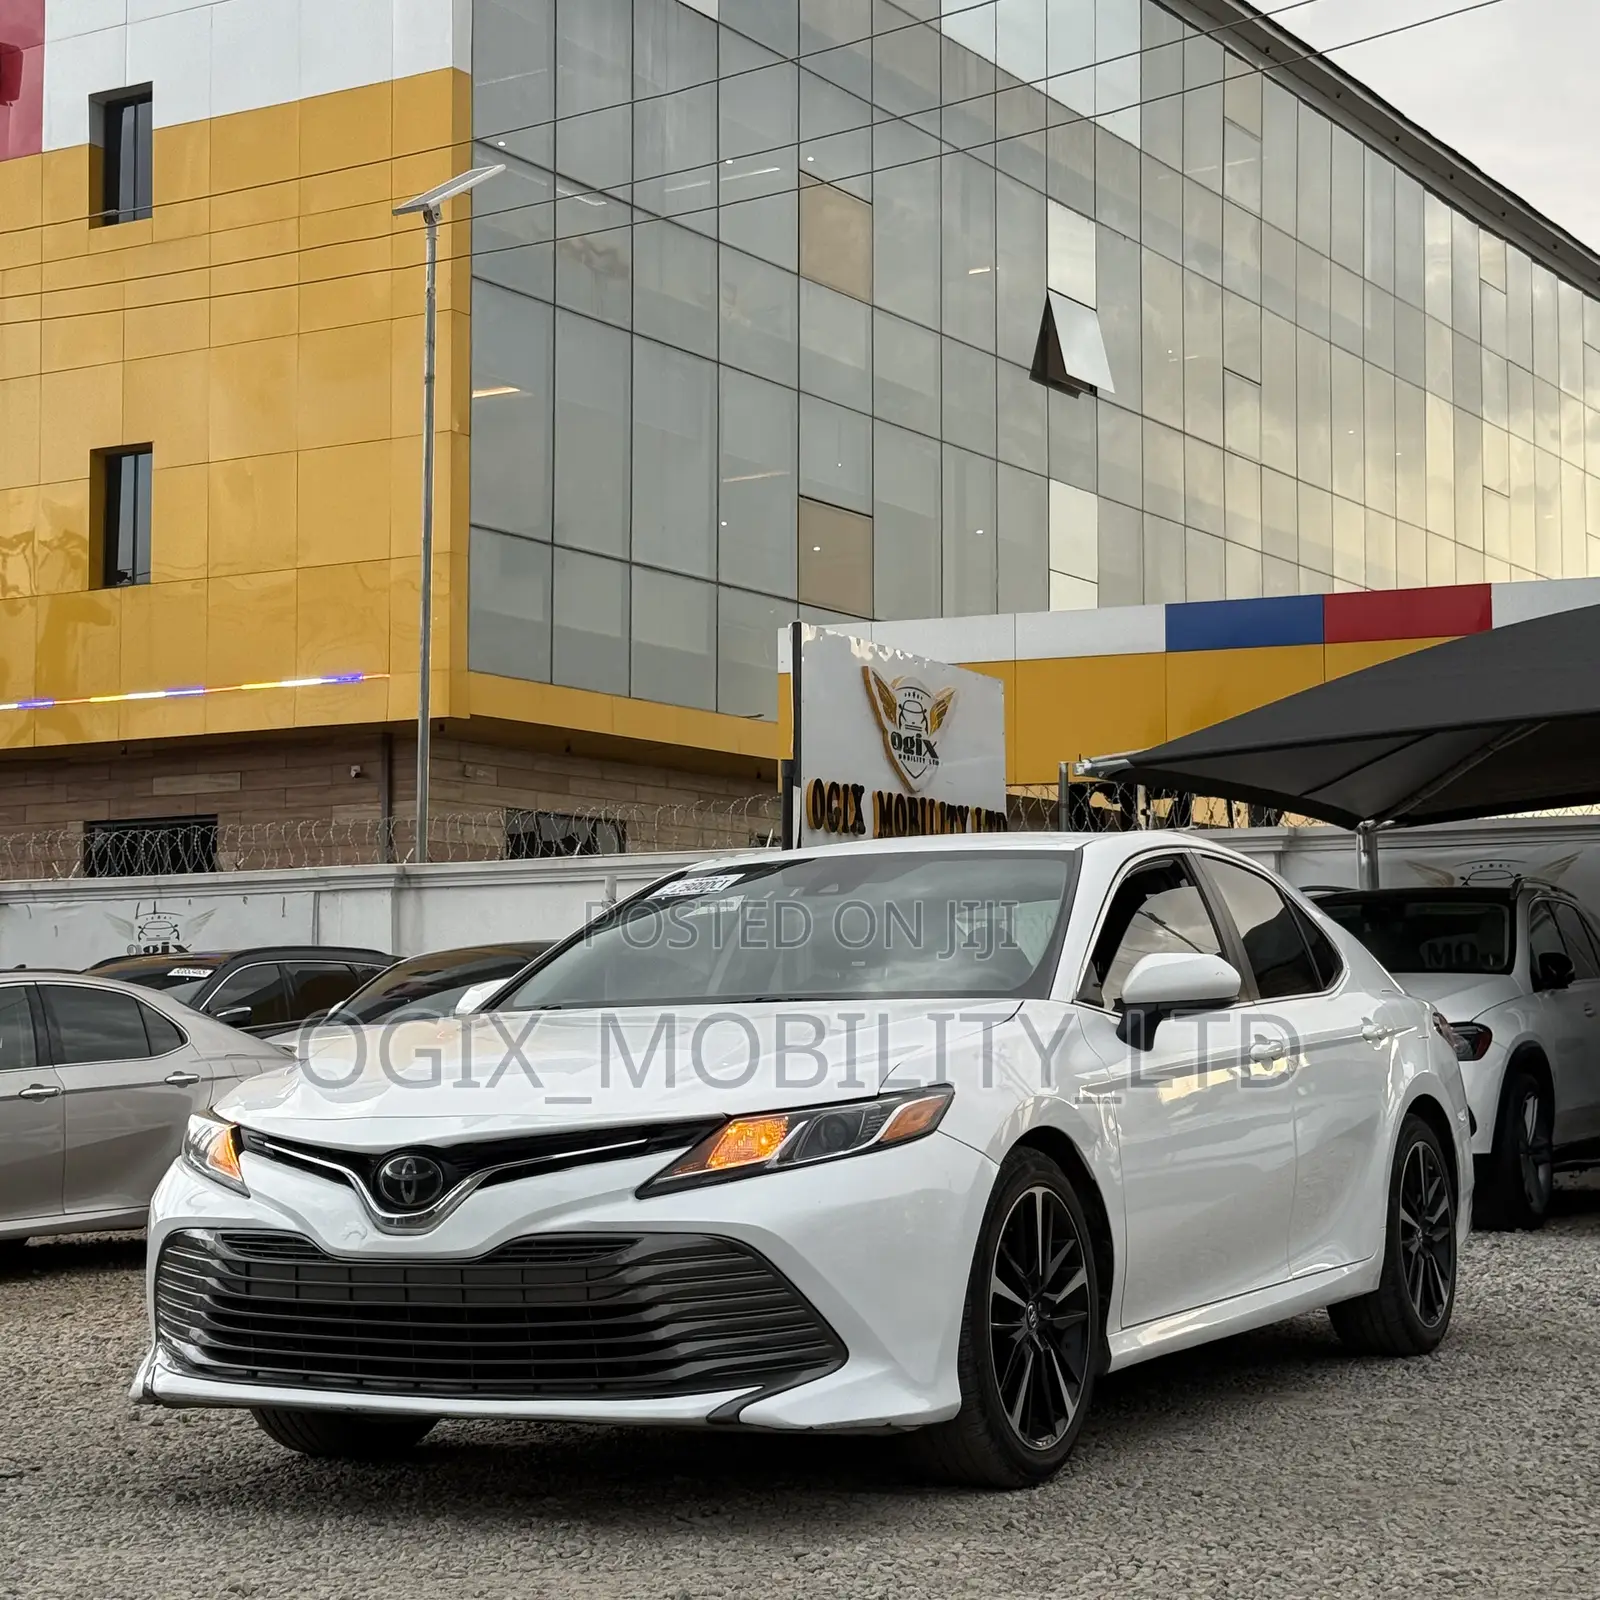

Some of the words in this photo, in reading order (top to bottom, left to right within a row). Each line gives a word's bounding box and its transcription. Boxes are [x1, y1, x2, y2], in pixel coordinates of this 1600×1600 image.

[891, 731, 940, 760] ogix
[807, 778, 866, 836] OGIX
[872, 789, 969, 838] MOBILITY
